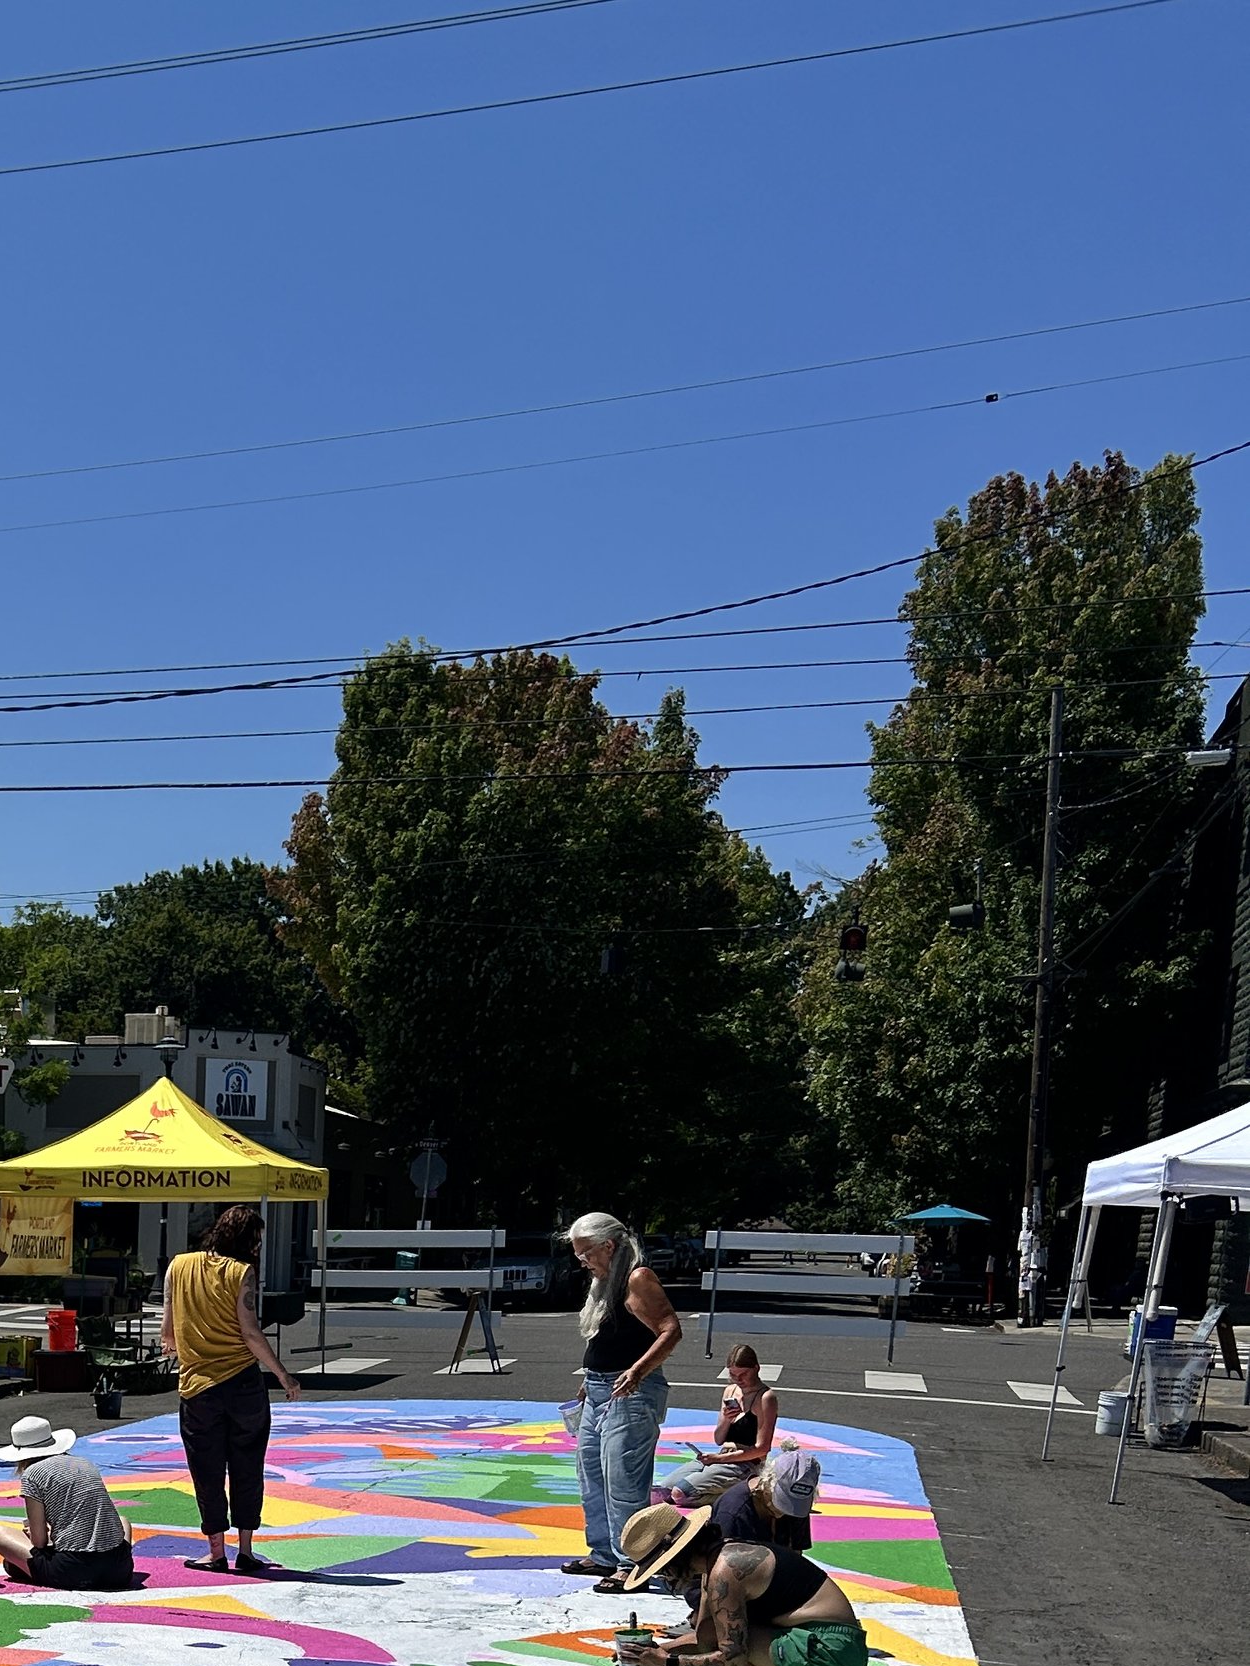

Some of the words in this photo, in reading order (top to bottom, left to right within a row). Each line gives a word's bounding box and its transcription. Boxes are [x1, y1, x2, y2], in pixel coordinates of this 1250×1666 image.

[216, 1093, 256, 1118] SAWAN
[95, 1145, 136, 1153] FARMERS
[137, 1146, 177, 1155] MARKET
[82, 1170, 231, 1188] INFORMATION
[11, 1234, 38, 1259] FARMERS
[38, 1235, 66, 1260] MARKET
